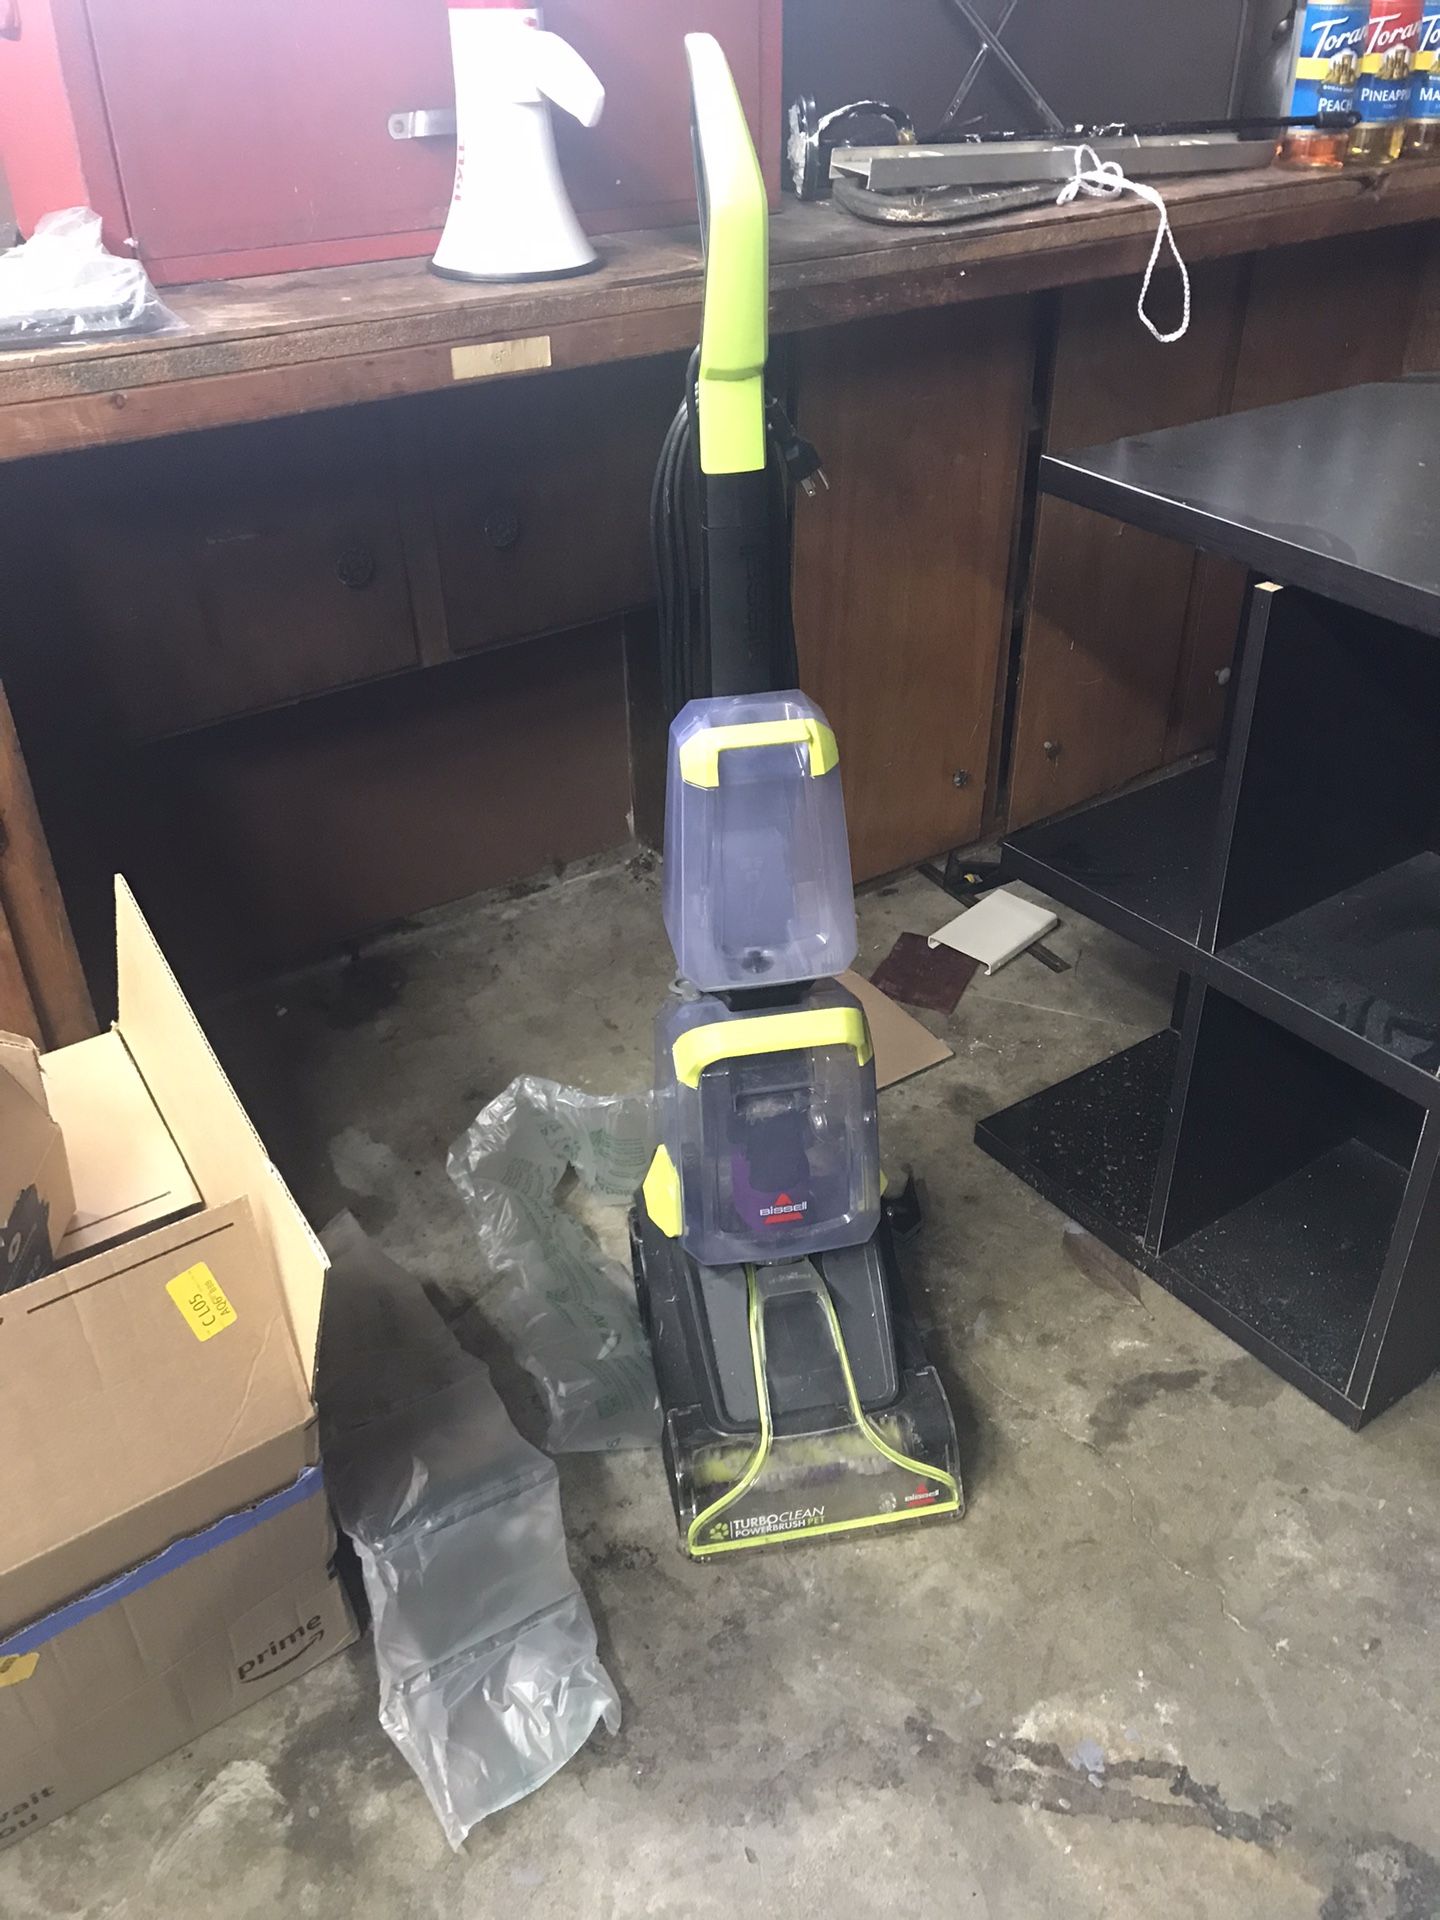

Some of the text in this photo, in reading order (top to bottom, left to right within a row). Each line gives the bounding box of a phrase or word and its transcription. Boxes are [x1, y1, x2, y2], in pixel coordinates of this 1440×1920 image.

[1318, 97, 1352, 113] PEACH
[733, 1505, 825, 1530] TURBOCLEAN
[734, 1519, 806, 1538] POWERBRUSH
[237, 1613, 322, 1681] prime
